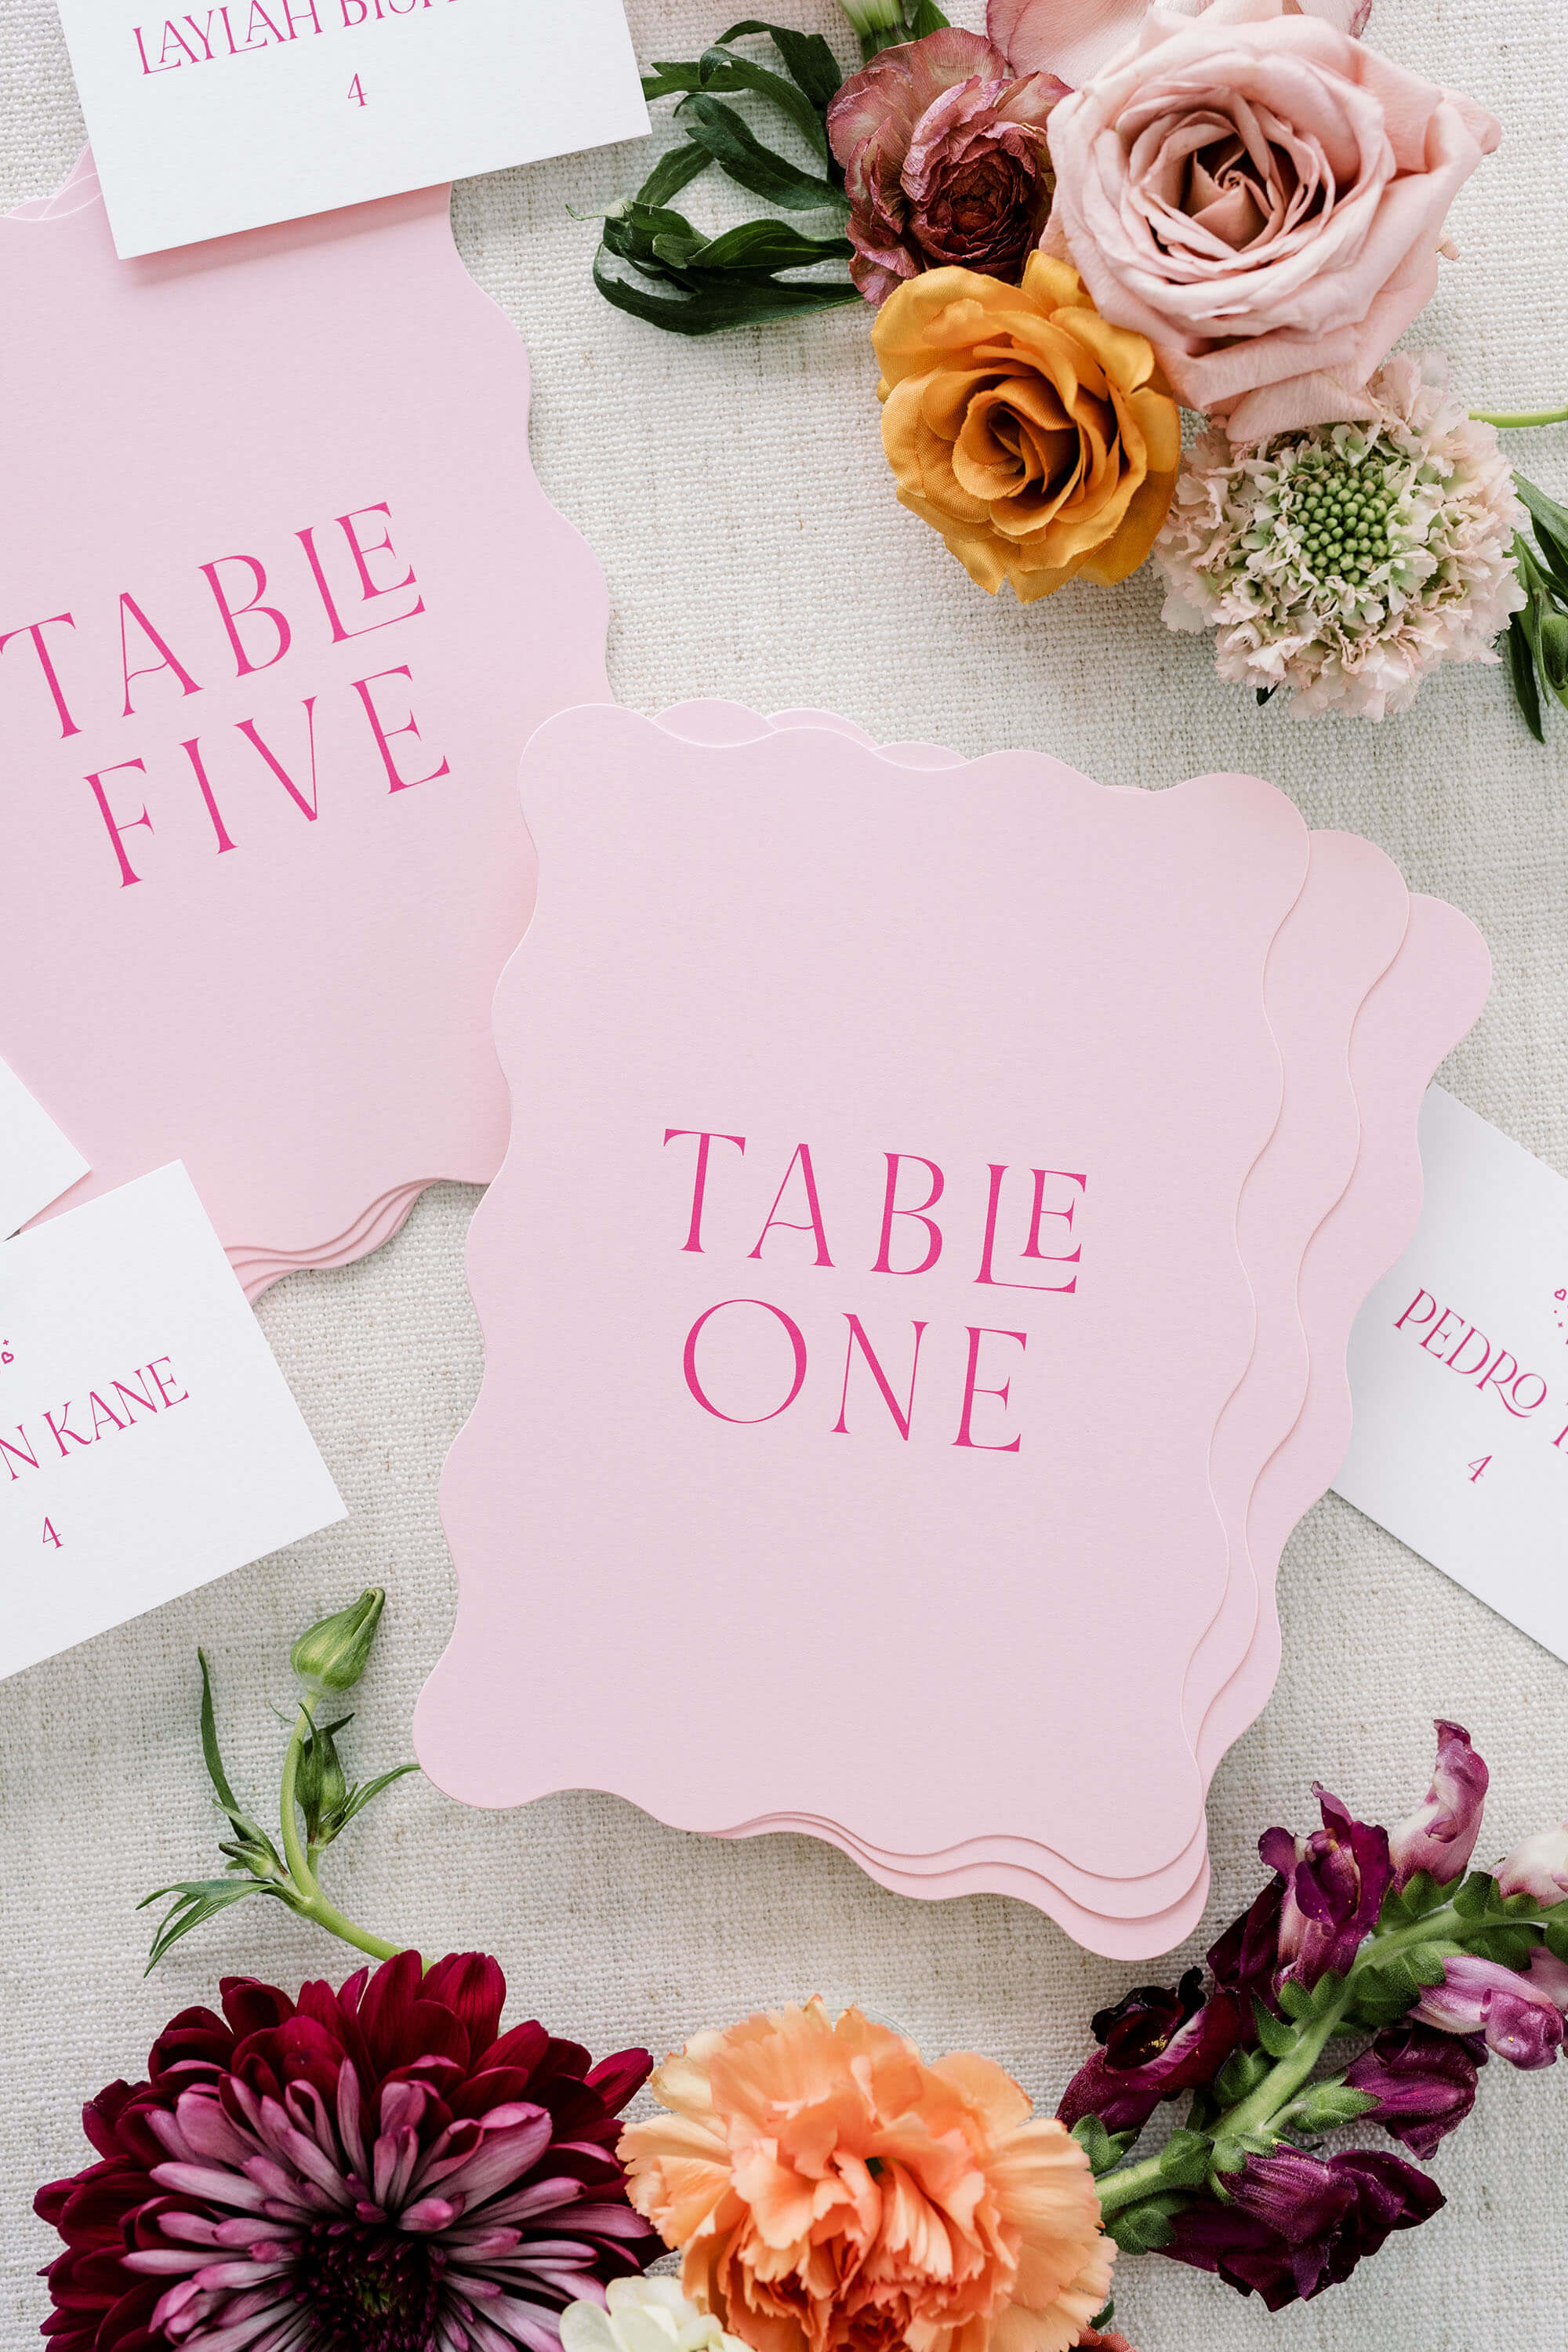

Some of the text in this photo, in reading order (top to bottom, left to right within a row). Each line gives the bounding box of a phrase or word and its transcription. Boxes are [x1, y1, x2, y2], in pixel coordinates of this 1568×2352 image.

[132, 0, 325, 75] LAYLAH
[347, 73, 368, 107] 4
[0, 501, 426, 739] TABLE
[82, 664, 451, 888] FIVE
[663, 1128, 1087, 1294] TABLE
[42, 1356, 190, 1457] KANE
[683, 1298, 1027, 1453] ONE
[1392, 1287, 1548, 1418] PEDRO
[1468, 1454, 1493, 1483] 4
[42, 1515, 64, 1550] 4
